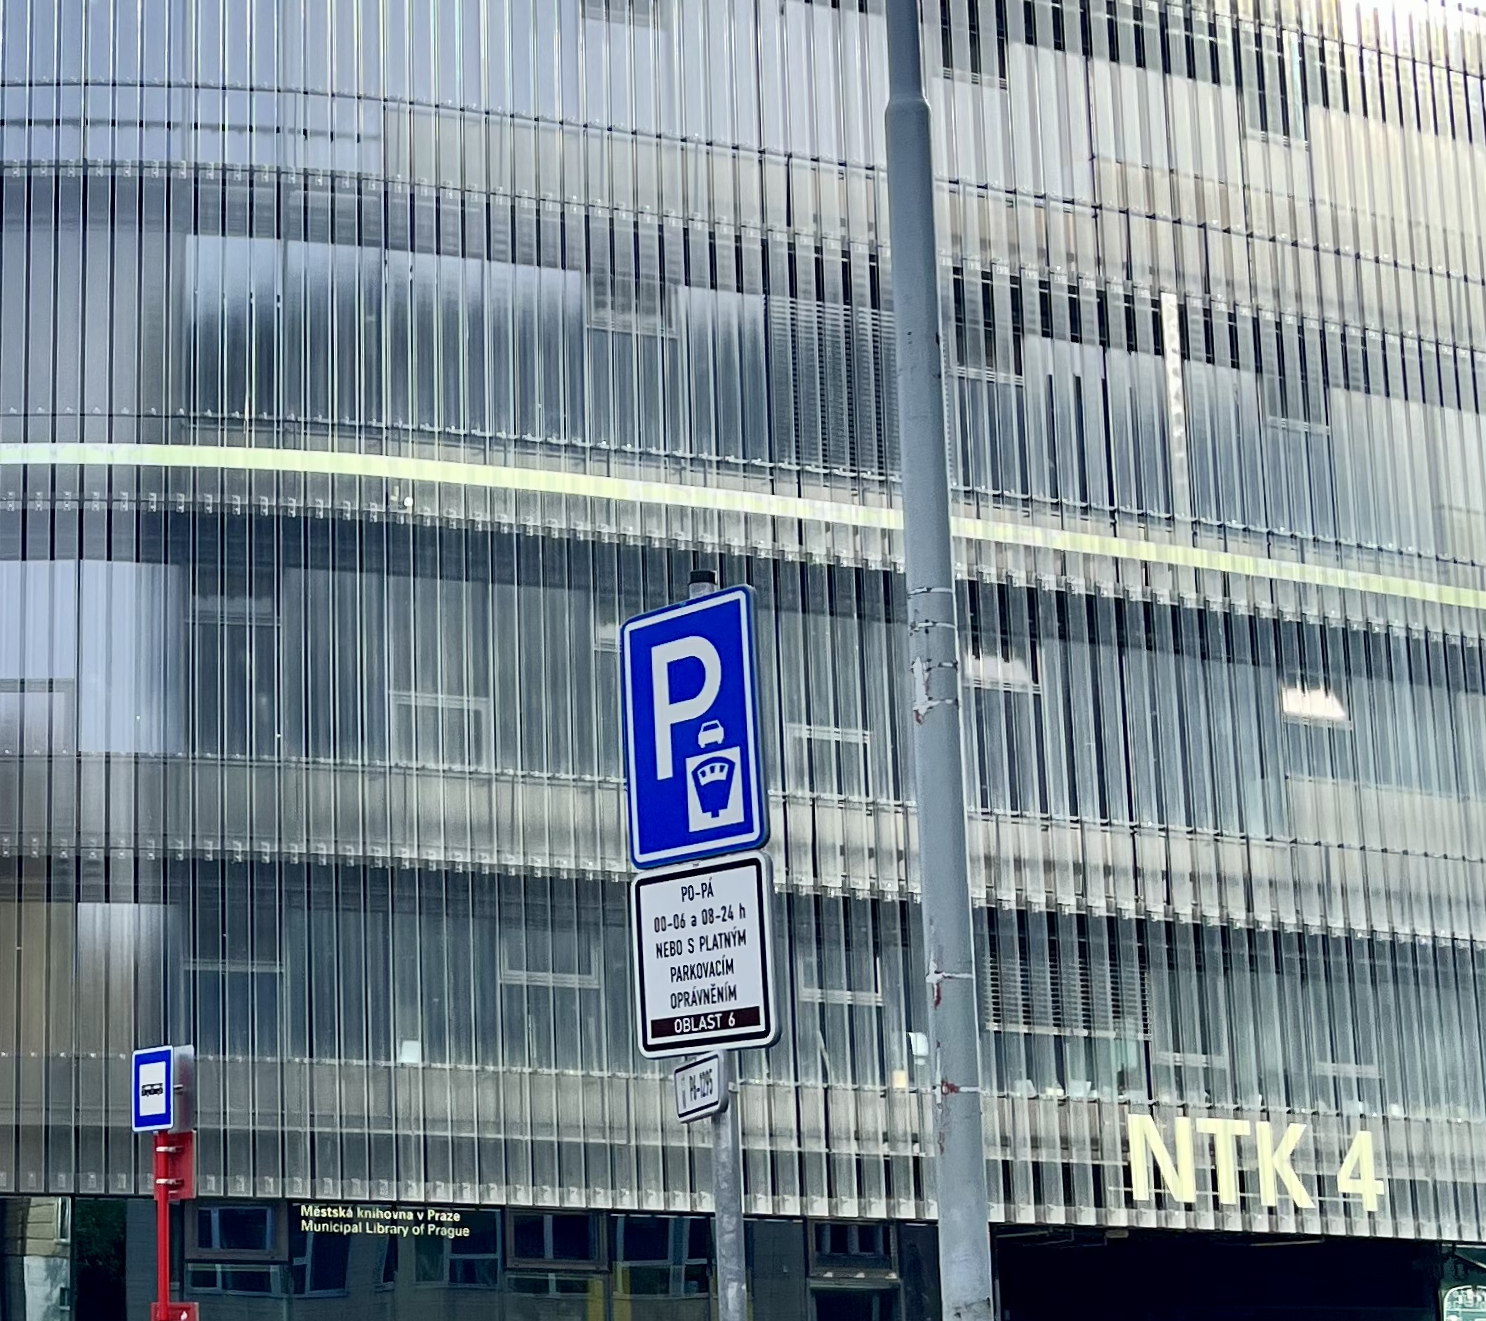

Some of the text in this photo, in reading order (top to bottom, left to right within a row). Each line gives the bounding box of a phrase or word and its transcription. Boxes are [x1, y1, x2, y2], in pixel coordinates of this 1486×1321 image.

[651, 635, 722, 781] P
[680, 876, 715, 902] PO-PÁ
[654, 902, 746, 933] 00-06 a 08-24 h
[655, 925, 747, 959] NEBO S PLATNÝM
[670, 954, 735, 983] PARKOVACÍM
[670, 981, 738, 1009] OPRÁVNĚNÍM
[674, 1011, 736, 1033] OBLAST 6
[1127, 1113, 1385, 1212] NTK 4
[300, 1204, 461, 1222] Městská knihovna v Praze
[301, 1219, 471, 1239] Municipal Library of Prague
